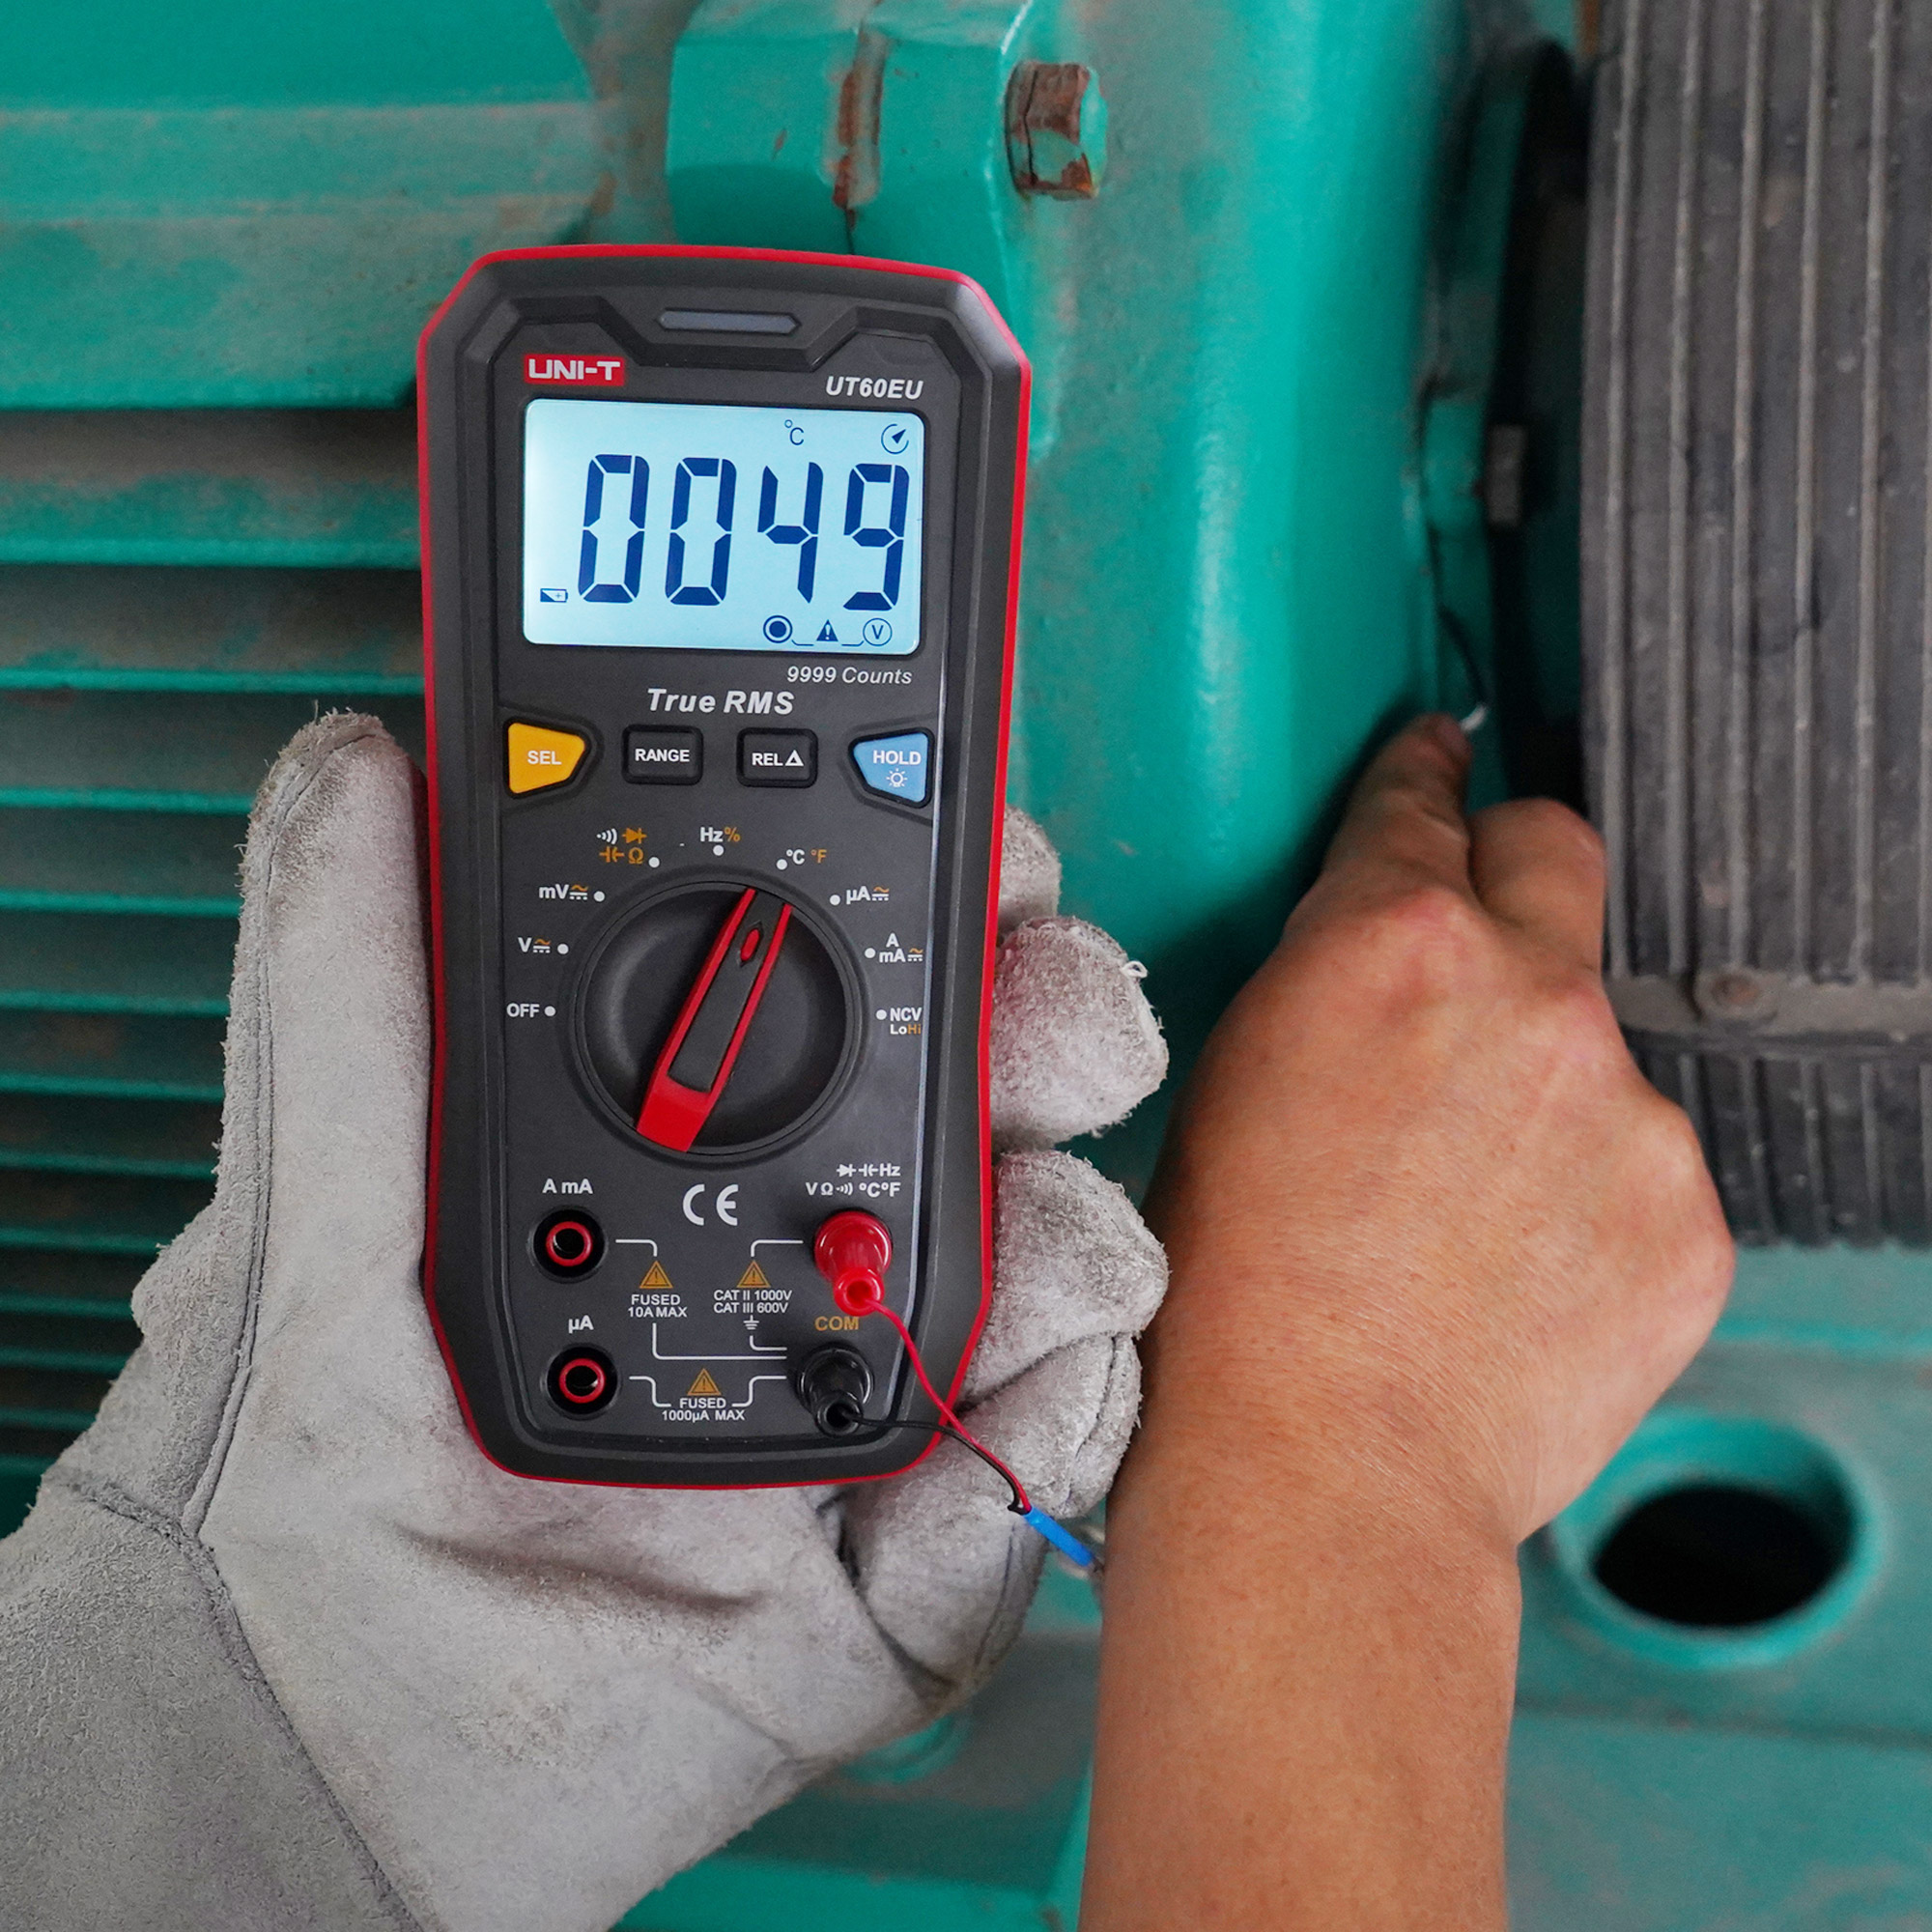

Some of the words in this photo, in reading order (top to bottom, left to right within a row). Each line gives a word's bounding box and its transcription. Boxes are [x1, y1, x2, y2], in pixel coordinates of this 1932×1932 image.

[528, 359, 619, 380] UNI-T
[826, 377, 923, 399] UT60EU
[578, 454, 909, 611] 0049
[787, 667, 837, 683] 9999
[841, 668, 913, 685] Counts
[648, 689, 715, 714] True
[724, 690, 794, 714] RMS
[527, 751, 561, 765] SEL
[635, 749, 690, 762] RANGE
[873, 751, 921, 765] HOLD
[539, 885, 568, 899] mV
[518, 938, 532, 952] V
[887, 933, 898, 947] A
[879, 949, 905, 962] mA
[507, 1004, 539, 1017] OFF
[890, 1008, 922, 1021] NCV
[543, 1180, 556, 1193] A
[561, 1180, 592, 1194] mA
[682, 1184, 738, 1226] CE
[632, 1294, 680, 1305] FUSED
[714, 1290, 738, 1301] CAT
[754, 1290, 792, 1301] 1000V
[628, 1307, 653, 1318] 10A
[656, 1307, 687, 1318] MAX
[714, 1302, 738, 1313] CAT
[756, 1302, 788, 1313] 600V
[815, 1317, 859, 1330] COM
[680, 1398, 726, 1409] FUSED
[715, 1409, 745, 1421] MAX
